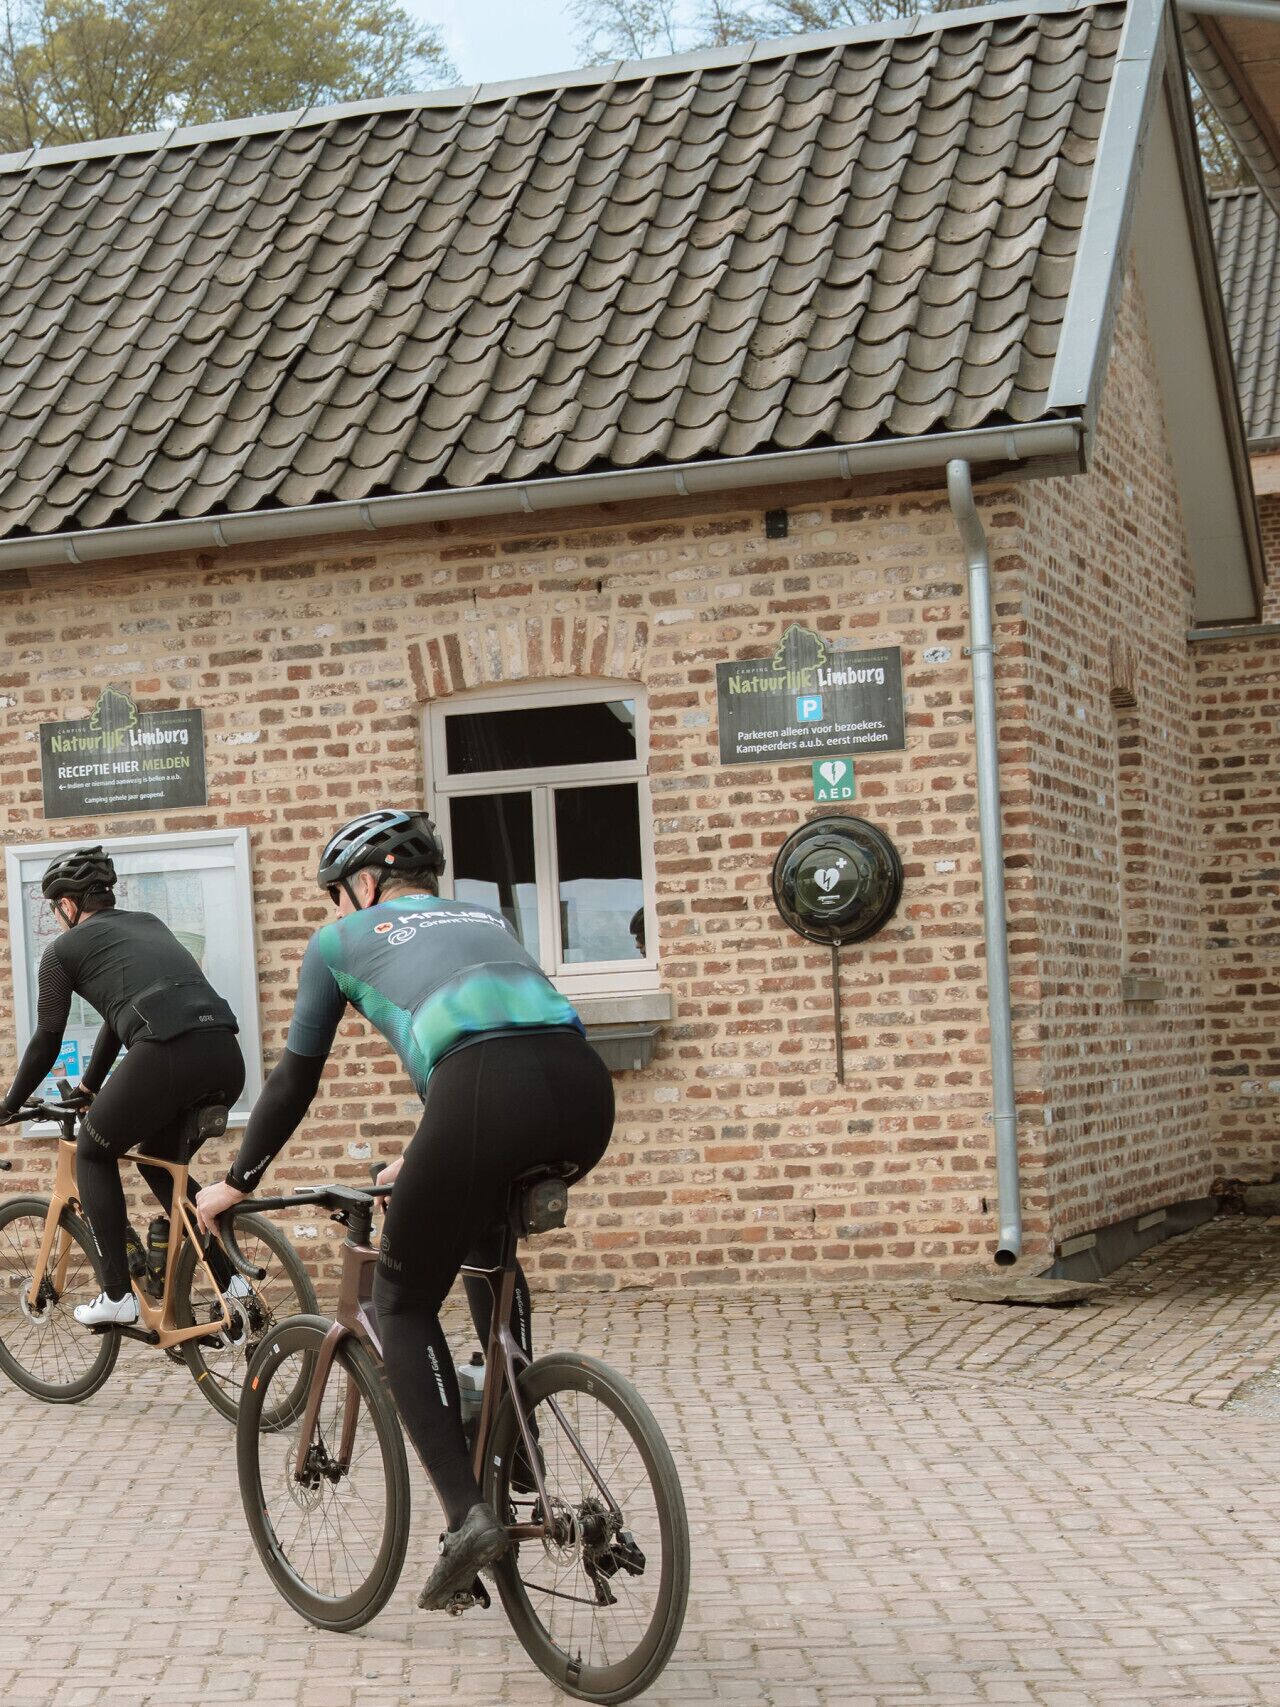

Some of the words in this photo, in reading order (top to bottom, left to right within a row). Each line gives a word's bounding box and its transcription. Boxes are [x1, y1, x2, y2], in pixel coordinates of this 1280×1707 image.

[728, 669, 812, 695] Natuurlijk
[817, 666, 885, 687] Limburg
[802, 700, 817, 718] P
[51, 730, 125, 754] Natuurlijk
[129, 727, 189, 747] Limburg
[738, 730, 779, 741] Parkeren
[780, 727, 809, 737] alleen
[811, 725, 832, 734] voor
[835, 720, 886, 732] bezoekers.
[736, 739, 797, 754] Kampeerders
[799, 738, 824, 748] a.u.b.
[826, 735, 851, 746] eerst
[852, 732, 888, 744] melden
[58, 763, 110, 779] RECEPTIE
[112, 760, 139, 774] HIER
[142, 756, 190, 772] MELDEN
[84, 796, 109, 805] Camping
[817, 787, 852, 800] AED
